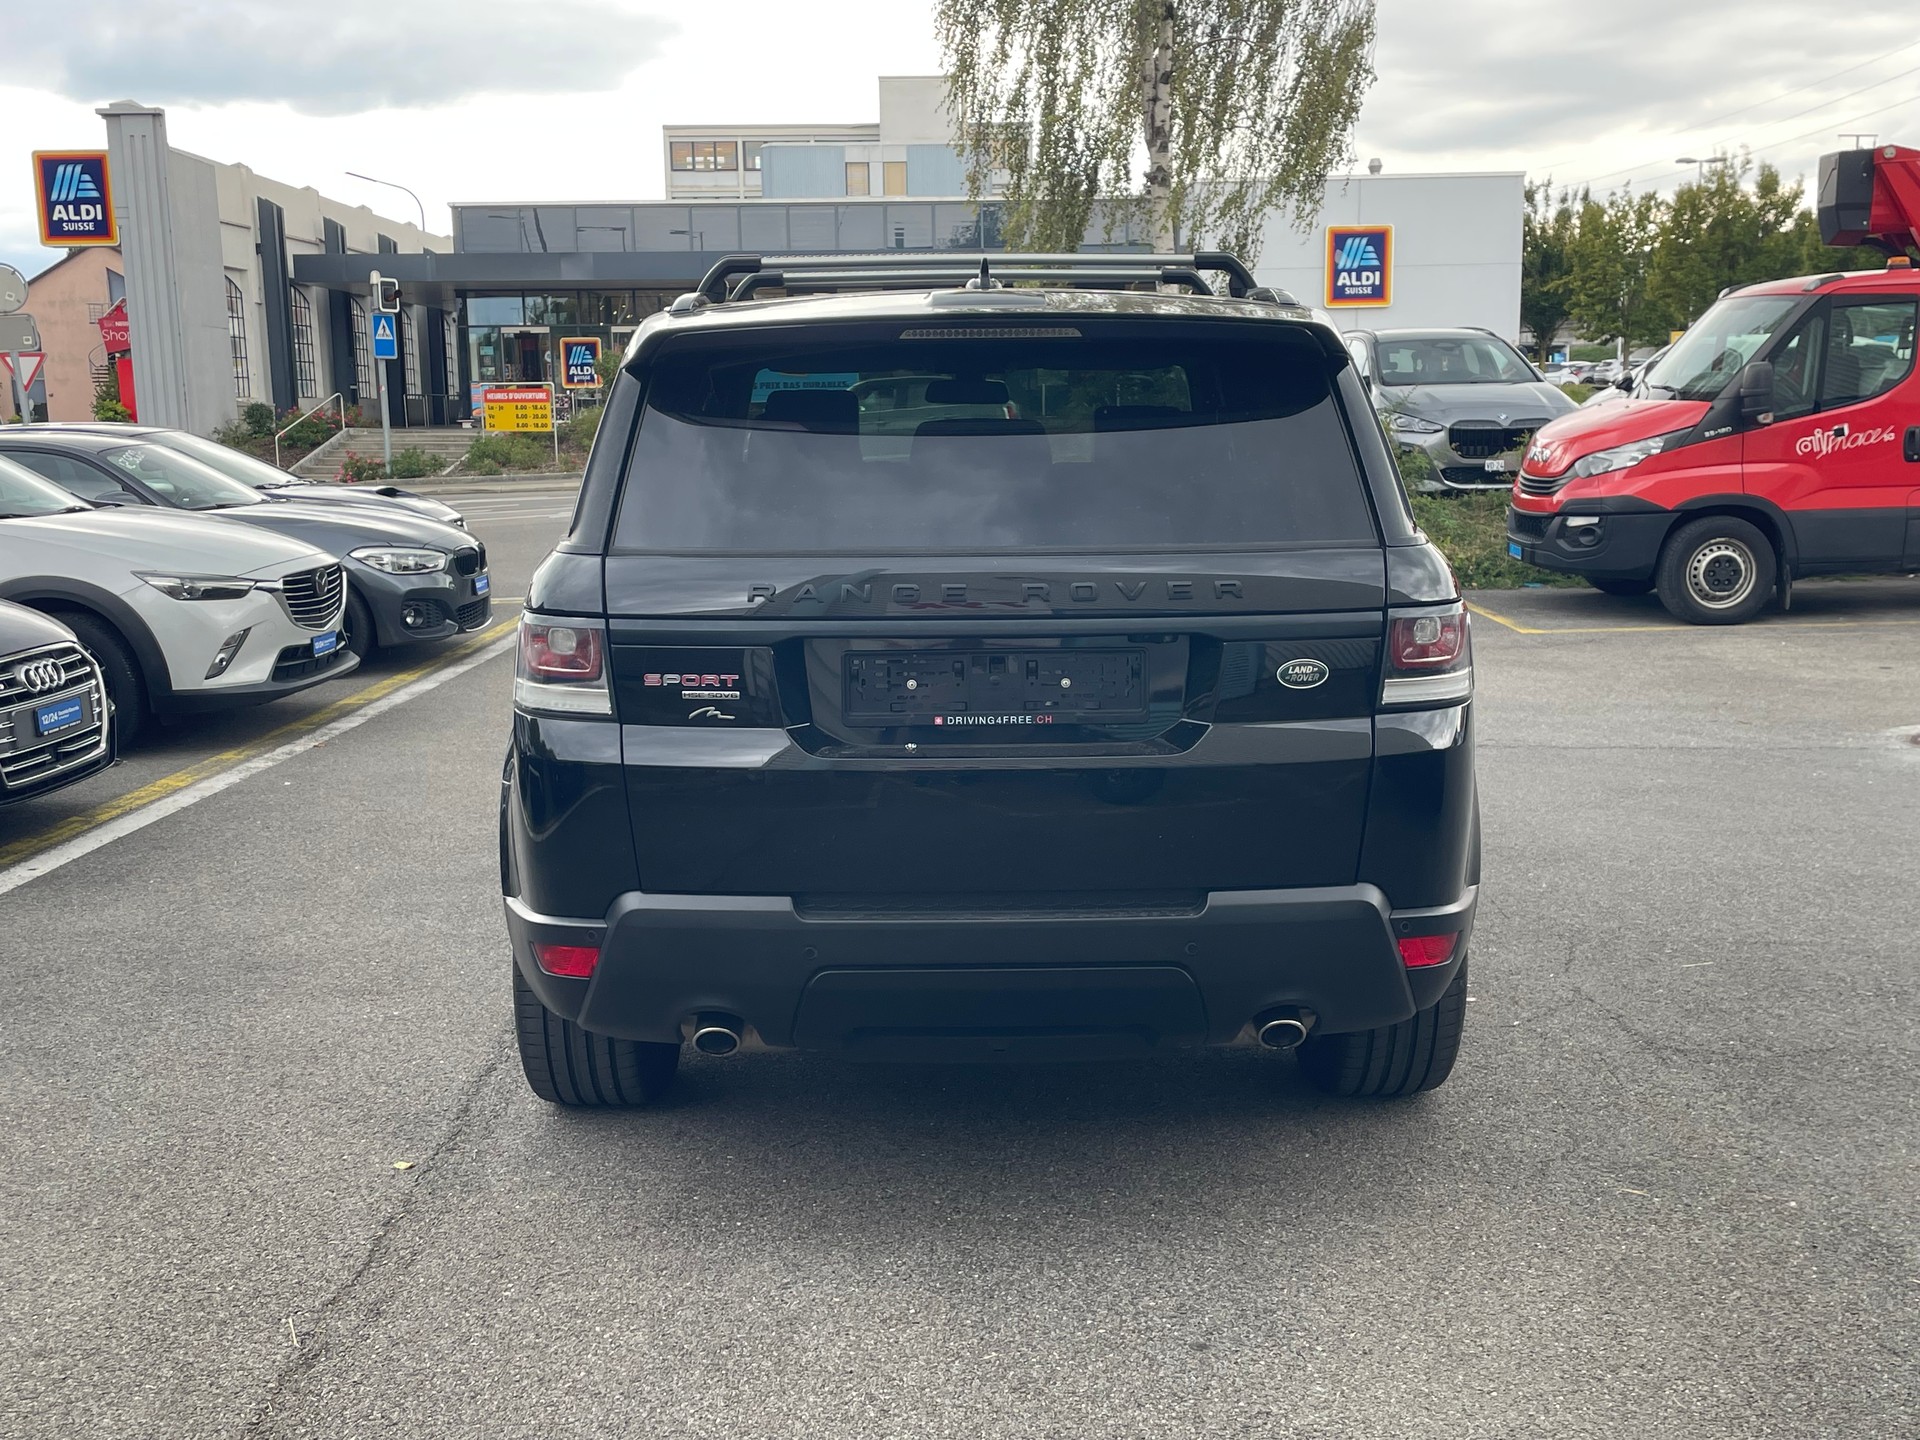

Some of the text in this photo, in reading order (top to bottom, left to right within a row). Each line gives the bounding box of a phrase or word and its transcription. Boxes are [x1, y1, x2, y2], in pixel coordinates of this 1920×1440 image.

[52, 204, 103, 221] ALDI
[62, 222, 95, 231] SUISSE
[1337, 271, 1381, 286] ALDI
[1344, 286, 1373, 295] SUISSE
[486, 392, 548, 400] HEURES D'OUVERTURE
[747, 580, 1244, 604] RANGE ROVER
[1288, 666, 1313, 674] LAND
[643, 673, 740, 687] SPORT
[1290, 674, 1320, 682] ROVER
[947, 715, 1053, 725] DRIVING4FREE.CH
